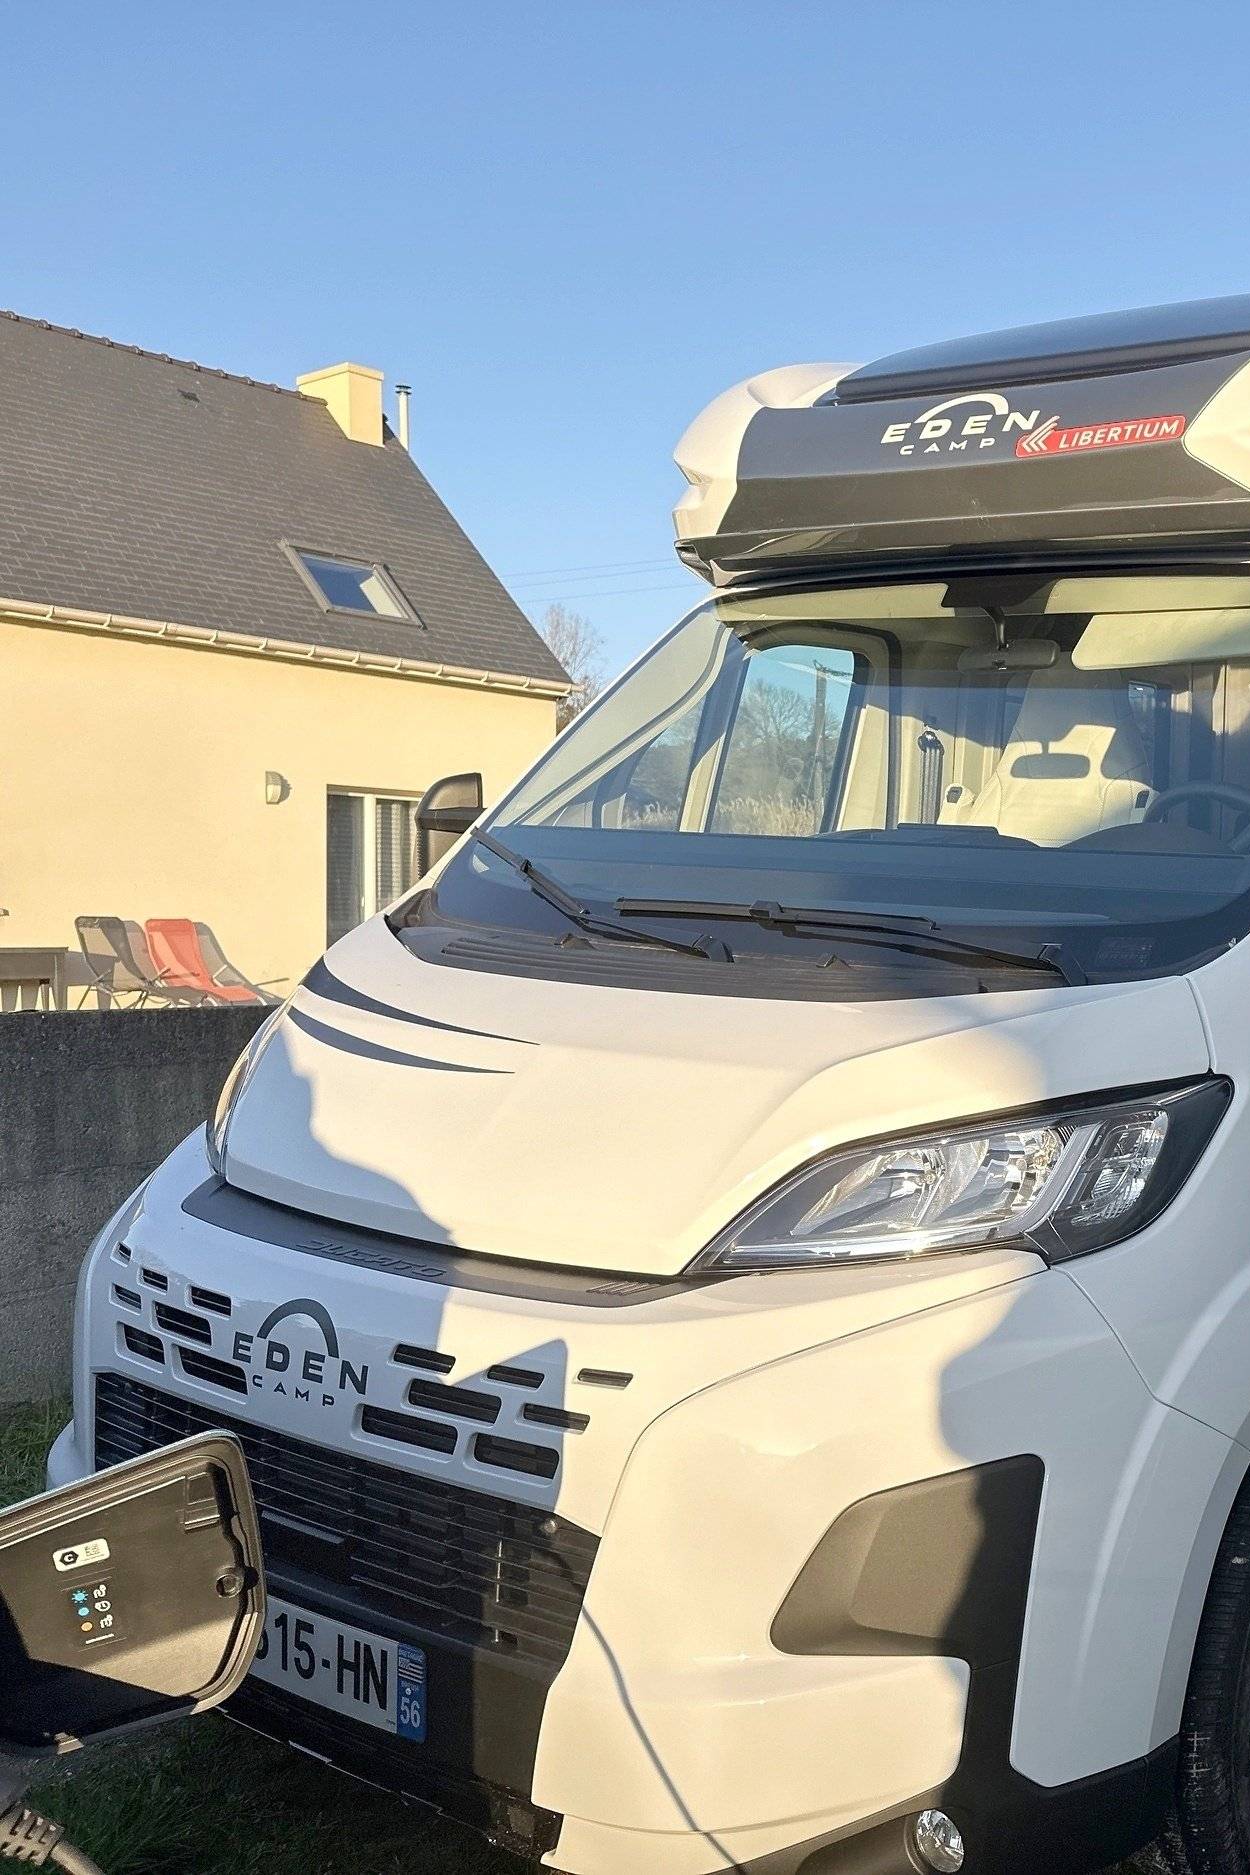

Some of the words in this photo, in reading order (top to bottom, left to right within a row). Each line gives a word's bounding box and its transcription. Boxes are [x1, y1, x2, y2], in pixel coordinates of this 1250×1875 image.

[881, 410, 1040, 443] EDEN
[1058, 420, 1179, 449] LIBERTIUM
[900, 437, 995, 455] CAMP
[233, 1331, 368, 1395] EDEN
[252, 1374, 335, 1407] CAMP
[400, 1697, 421, 1728] 56
